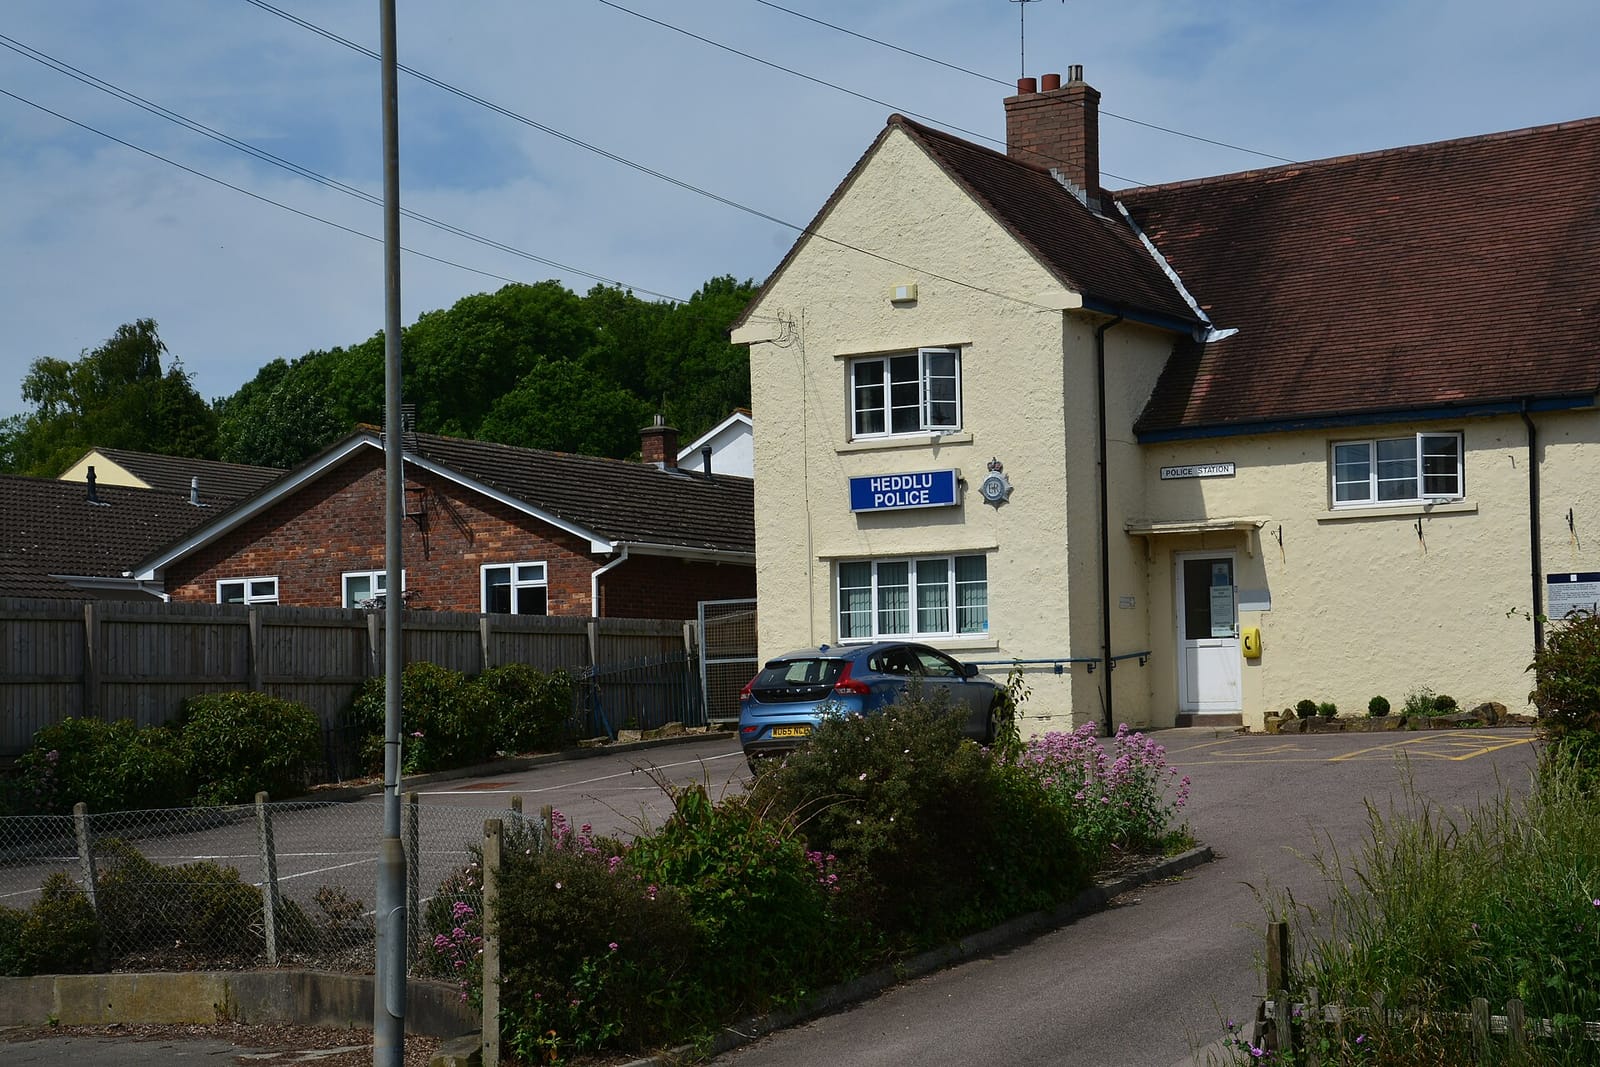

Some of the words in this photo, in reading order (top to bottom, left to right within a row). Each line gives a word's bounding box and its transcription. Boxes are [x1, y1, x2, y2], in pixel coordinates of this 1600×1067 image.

[1165, 468, 1193, 477] POLICE
[1198, 465, 1230, 474] STATION
[870, 474, 932, 492] HEDDLU
[874, 490, 930, 507] POLICE
